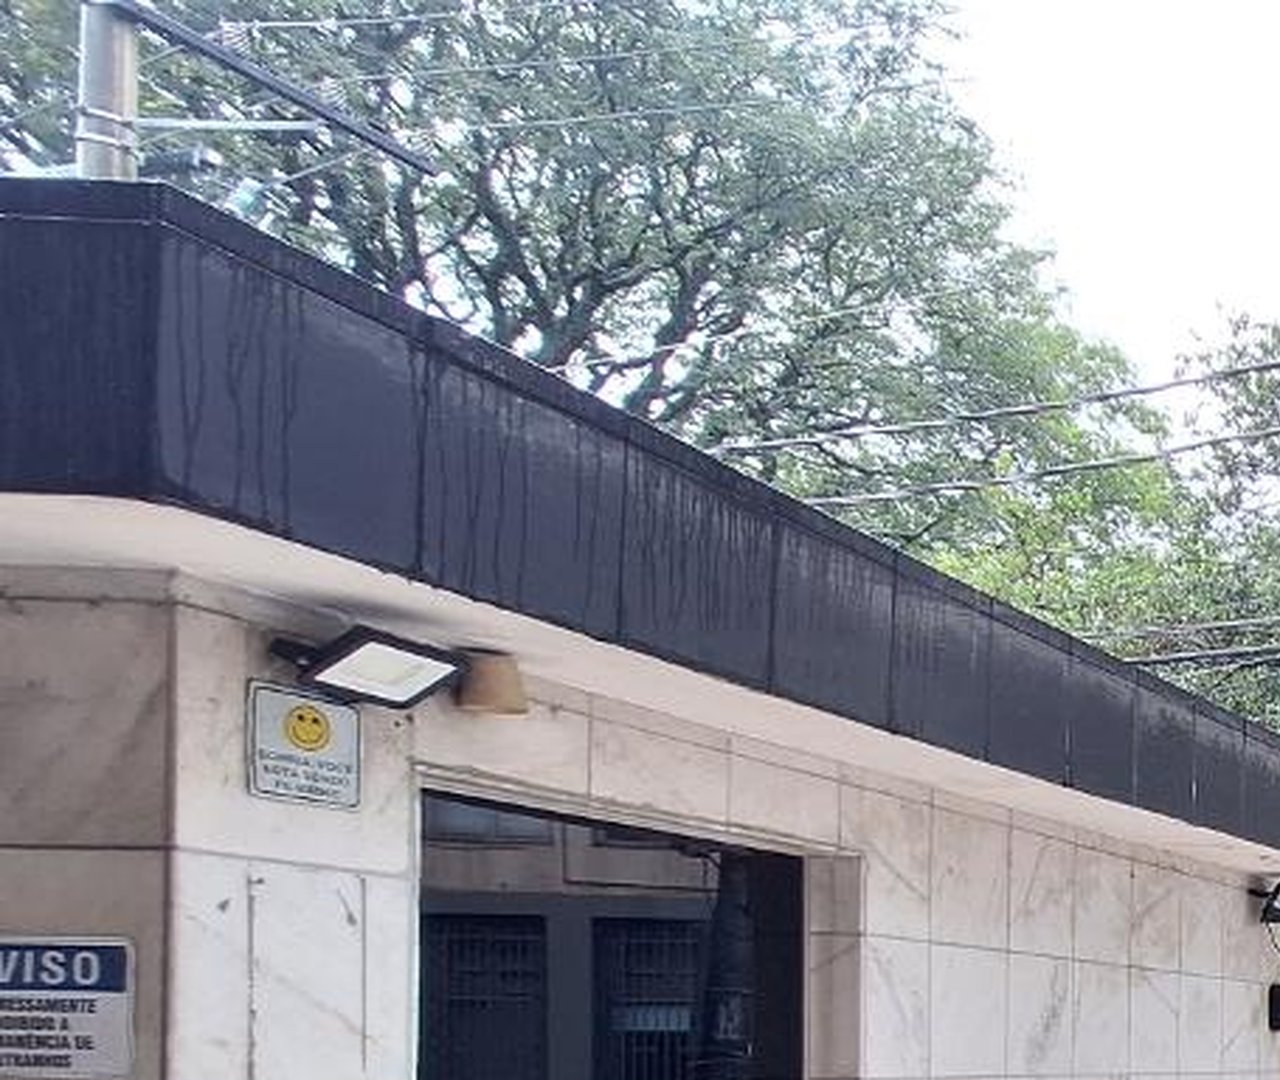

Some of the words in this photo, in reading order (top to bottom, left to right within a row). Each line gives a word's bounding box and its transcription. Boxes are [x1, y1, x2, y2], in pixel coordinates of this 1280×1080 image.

[0, 950, 99, 985] VISO
[0, 998, 97, 1014] RESSAMENTE
[0, 1015, 56, 1031] OIBIDO
[0, 1053, 72, 1068] TRANHOS
